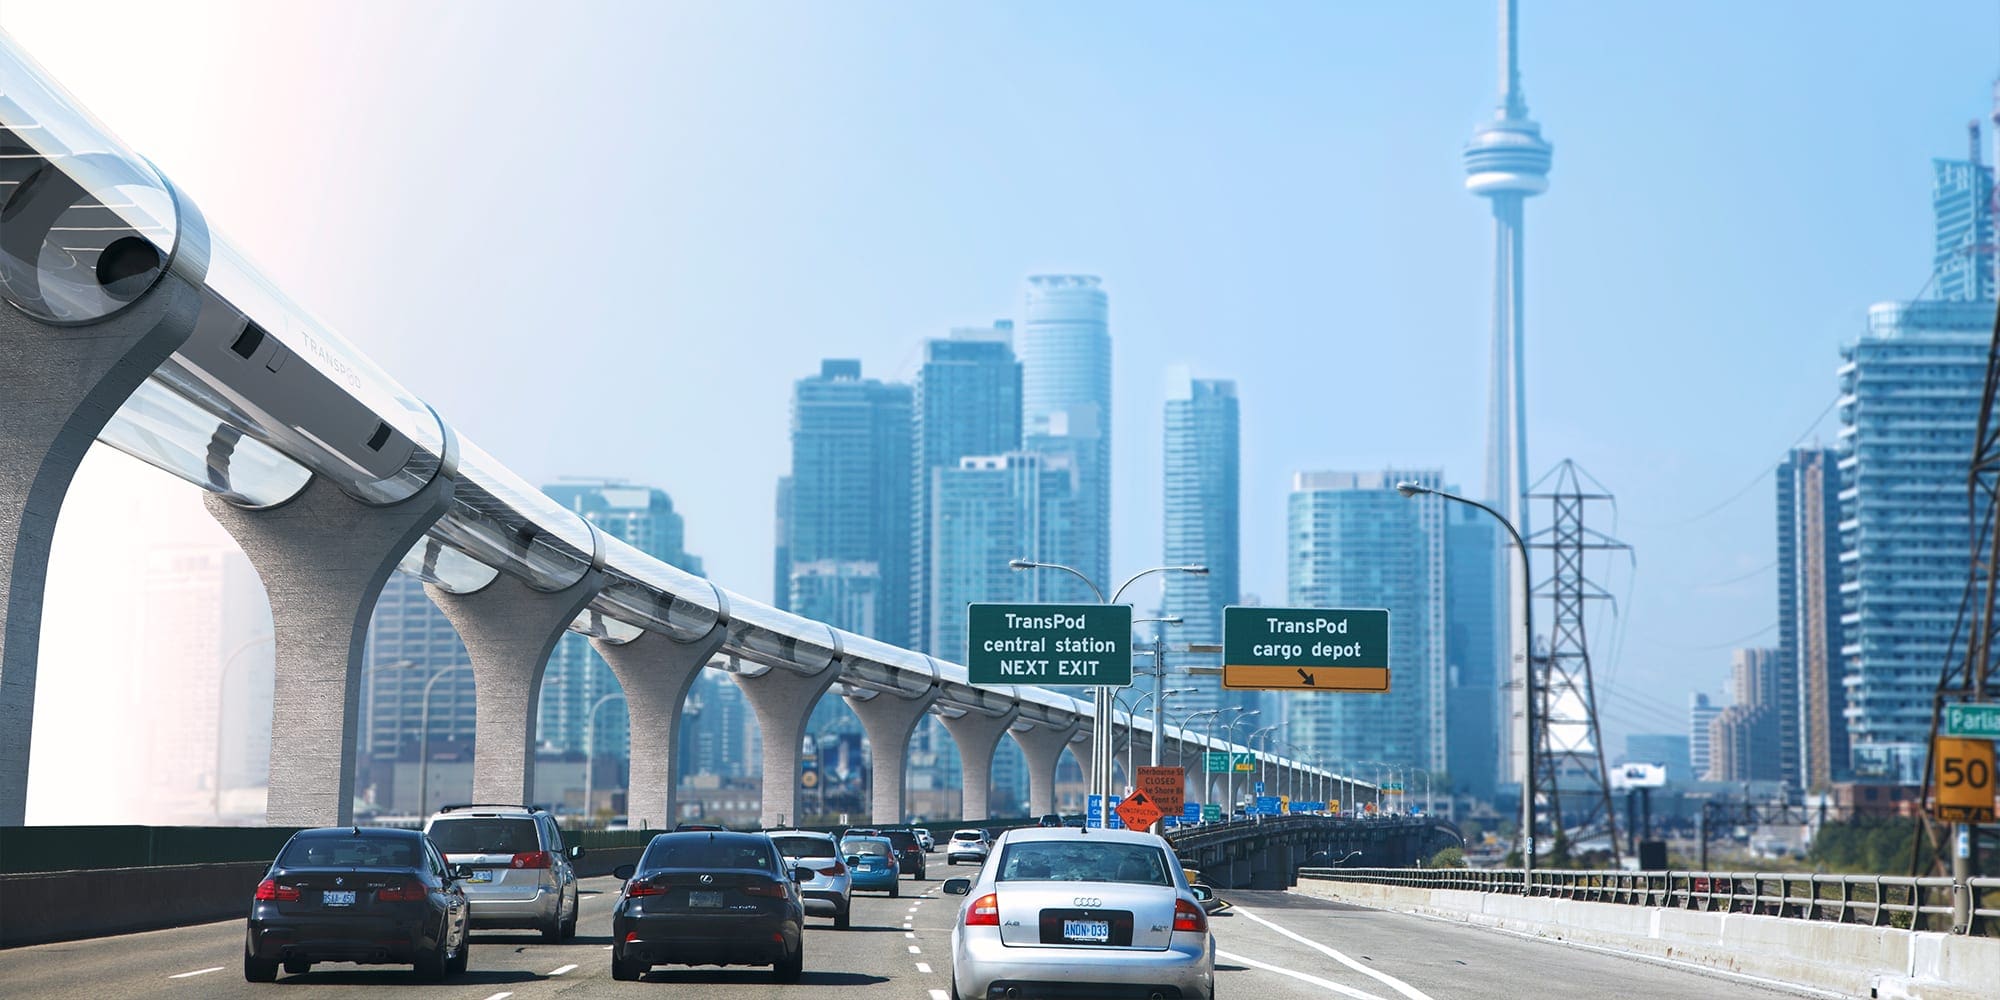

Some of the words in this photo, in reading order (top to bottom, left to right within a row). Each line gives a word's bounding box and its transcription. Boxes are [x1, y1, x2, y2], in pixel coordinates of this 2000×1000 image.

[1005, 613, 1086, 630] TransPod
[1267, 618, 1348, 634] TransPod
[983, 637, 1046, 653] central
[1055, 637, 1116, 653] station
[1253, 643, 1303, 660] cargo
[1311, 641, 1361, 660] depot
[1000, 660, 1049, 676] NEXT
[1058, 660, 1100, 676] EXIT
[1145, 777, 1176, 785] CLOSED
[1943, 757, 1989, 789] 50
[1128, 816, 1134, 824] 2
[1137, 817, 1147, 825] km
